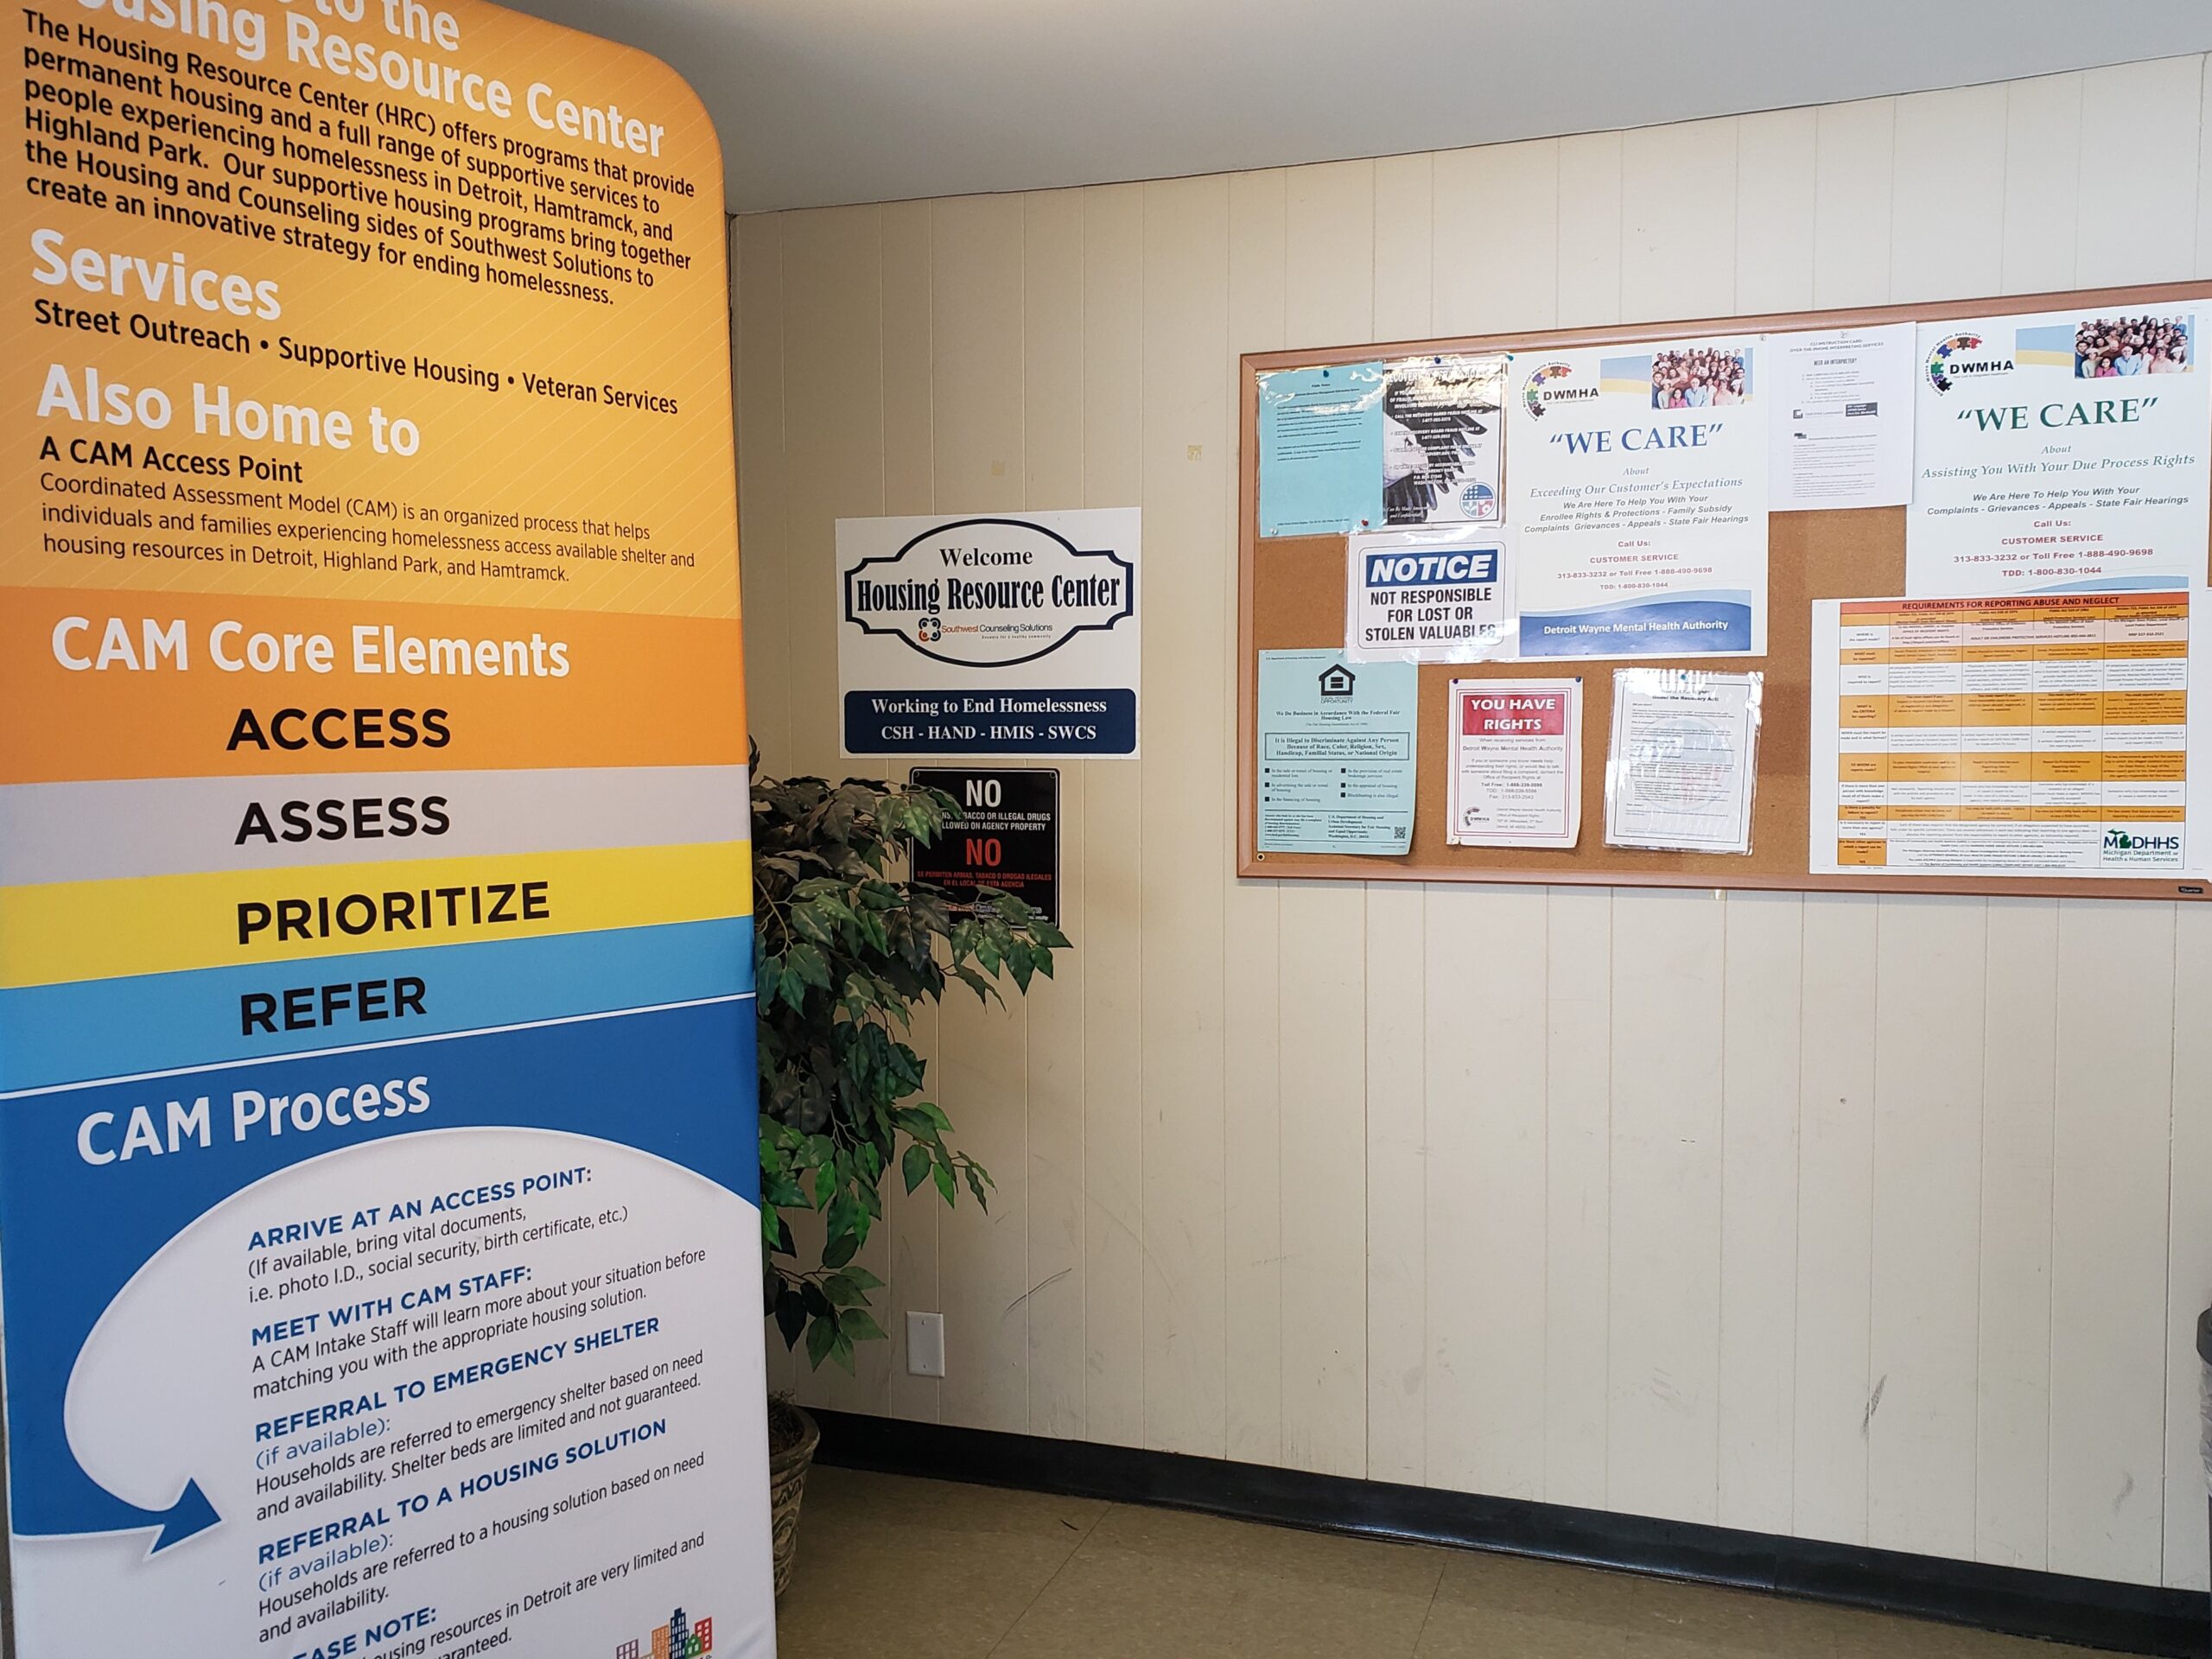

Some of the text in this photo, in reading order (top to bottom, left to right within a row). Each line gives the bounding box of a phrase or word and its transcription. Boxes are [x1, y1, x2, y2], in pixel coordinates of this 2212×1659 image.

[381, 0, 459, 51] the
[22, 8, 694, 197] The Housing Resource Center (HRC) offers programs that provide
[286, 10, 664, 157] Resource Center
[31, 228, 281, 320] Services
[35, 298, 677, 414] Street Outreach Supportive Housing Veteran Services
[1949, 359, 2013, 373] DWMHA
[36, 363, 419, 455] Also Home to
[1543, 387, 1599, 400] DWMHA
[1921, 454, 2194, 479] Assisting You With Your Due Process Rights
[1530, 486, 1581, 498] Exceeding
[1585, 485, 1605, 494] Our
[1672, 477, 1742, 491] Expectations
[43, 532, 569, 581] housing resources in Detroit, Highland Park, and Hamtramck.
[939, 547, 1032, 566] Welcome
[1370, 554, 1491, 582] NOTICE
[857, 574, 1120, 614] Housing Resource Center
[1370, 587, 1491, 605] NOT RESPONSIBLE
[1388, 606, 1472, 622] FOR LOST OR
[52, 616, 569, 677] CAM Core Elements
[979, 624, 1019, 633] Counseling
[1020, 623, 1052, 632] Solutions
[1365, 626, 1414, 641] STOLEN
[1544, 620, 1728, 634] Detroit Wayne Mental Health Authority
[871, 697, 1106, 716] Working to End Homelessness
[1471, 698, 1555, 709] YOU HAVE
[1484, 718, 1541, 729] RIGHTS
[226, 708, 450, 750] ACCESS
[881, 725, 1096, 739] CSH HAND HMIS SWCS
[966, 779, 1001, 807] NO
[234, 796, 449, 845] ASSESS
[970, 821, 980, 830] ON
[1010, 822, 1046, 830] PROPERTY
[966, 838, 1001, 866] NO
[238, 880, 549, 944] PRIORITIZE
[240, 976, 427, 1035] REFER
[77, 1076, 429, 1165] CAM Process
[248, 1166, 590, 1250] ARRIVE AT AN ACCESS POINT:
[249, 1205, 627, 1302] i.e. photo I.D., social security, birth certificate, etc.)
[251, 1265, 531, 1346] MEET WITH CAM STAFF:
[256, 1317, 658, 1442] REFERRAL TO EMERGENCY SHELTER
[258, 1418, 665, 1564] REFERRAL TO A HOUSING SOLUTION
